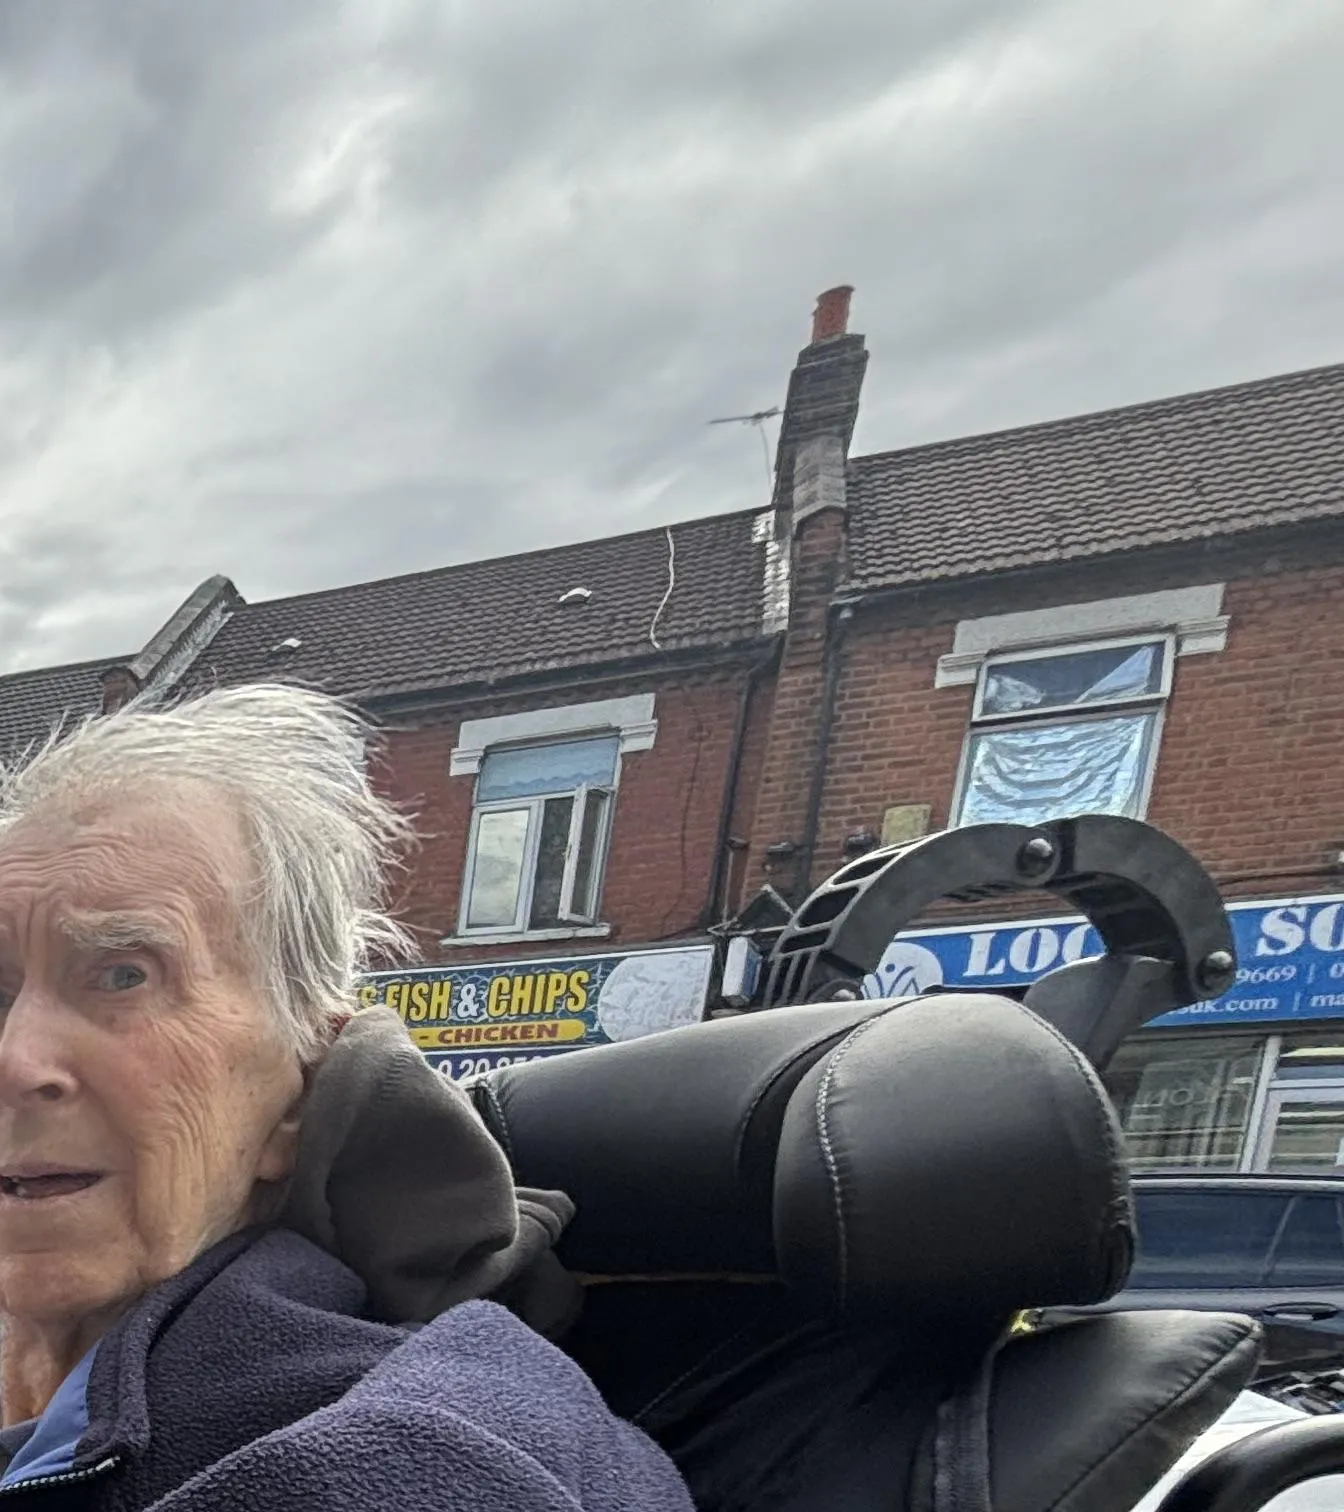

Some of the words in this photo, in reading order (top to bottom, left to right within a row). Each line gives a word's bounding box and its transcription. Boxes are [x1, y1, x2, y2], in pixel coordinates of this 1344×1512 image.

[385, 979, 452, 1022] FISH
[457, 983, 480, 1018] &
[487, 970, 591, 1018] CHIPS
[437, 1023, 560, 1045] CHICKEN
